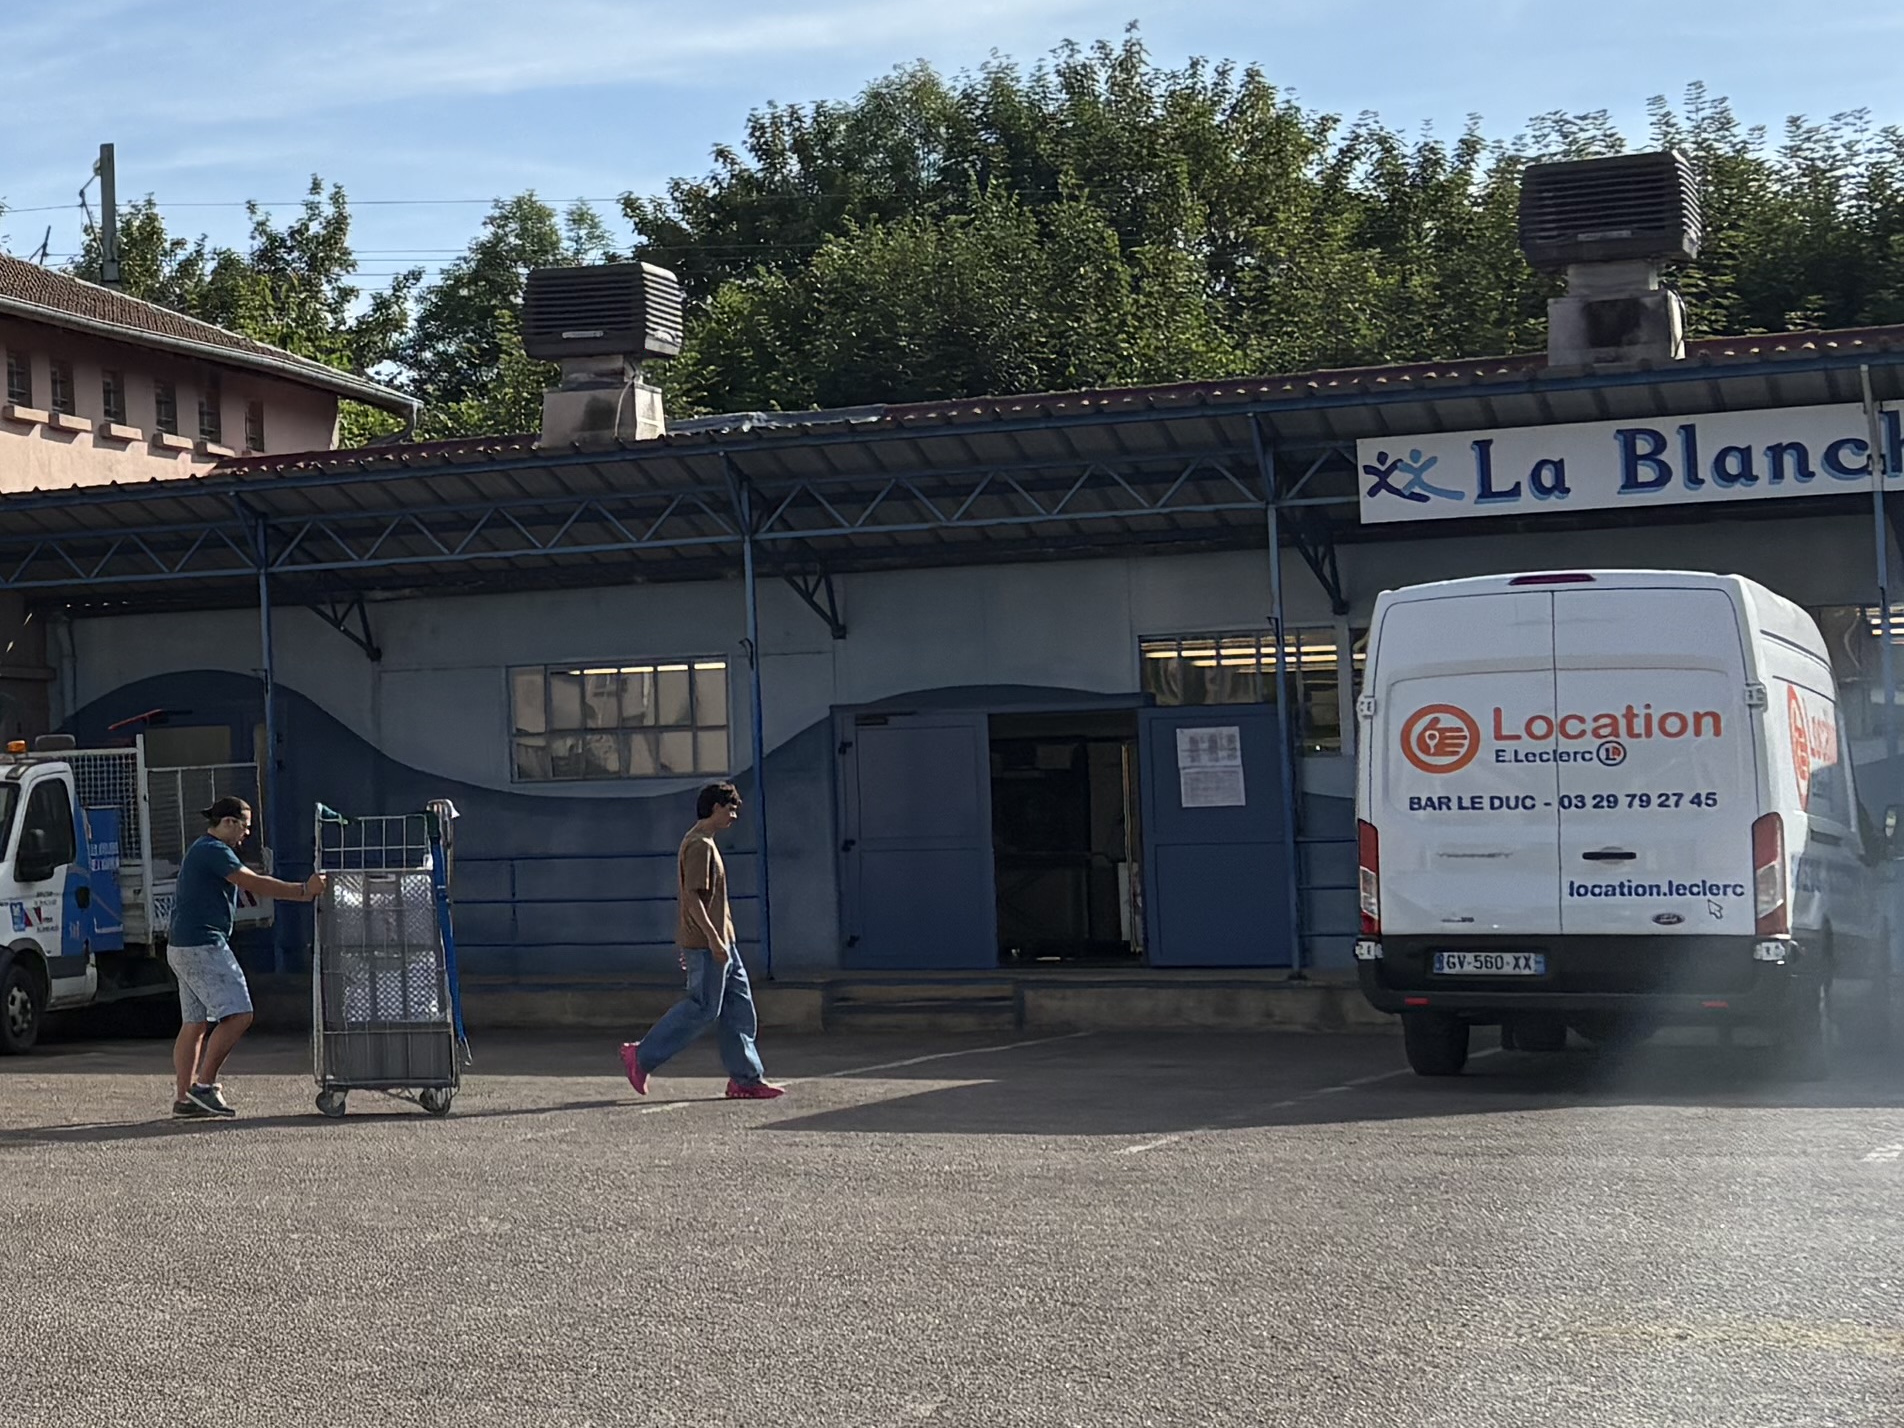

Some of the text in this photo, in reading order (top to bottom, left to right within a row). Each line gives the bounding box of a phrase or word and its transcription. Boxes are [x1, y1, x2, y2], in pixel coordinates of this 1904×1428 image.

[1471, 439, 1572, 504] La
[1494, 703, 1722, 741] Location
[1495, 749, 1593, 763] E.Leclerc
[1409, 795, 1452, 811] BAR
[1457, 795, 1485, 811] LE
[1490, 794, 1536, 811] DUC
[1559, 794, 1587, 810] 03
[1592, 793, 1619, 809] 29
[1625, 792, 1652, 809] 79
[1657, 792, 1684, 809] 27
[1689, 791, 1718, 808] 45
[1569, 879, 1745, 898] location.leclerc
[1446, 954, 1532, 971] GV-560-XX
